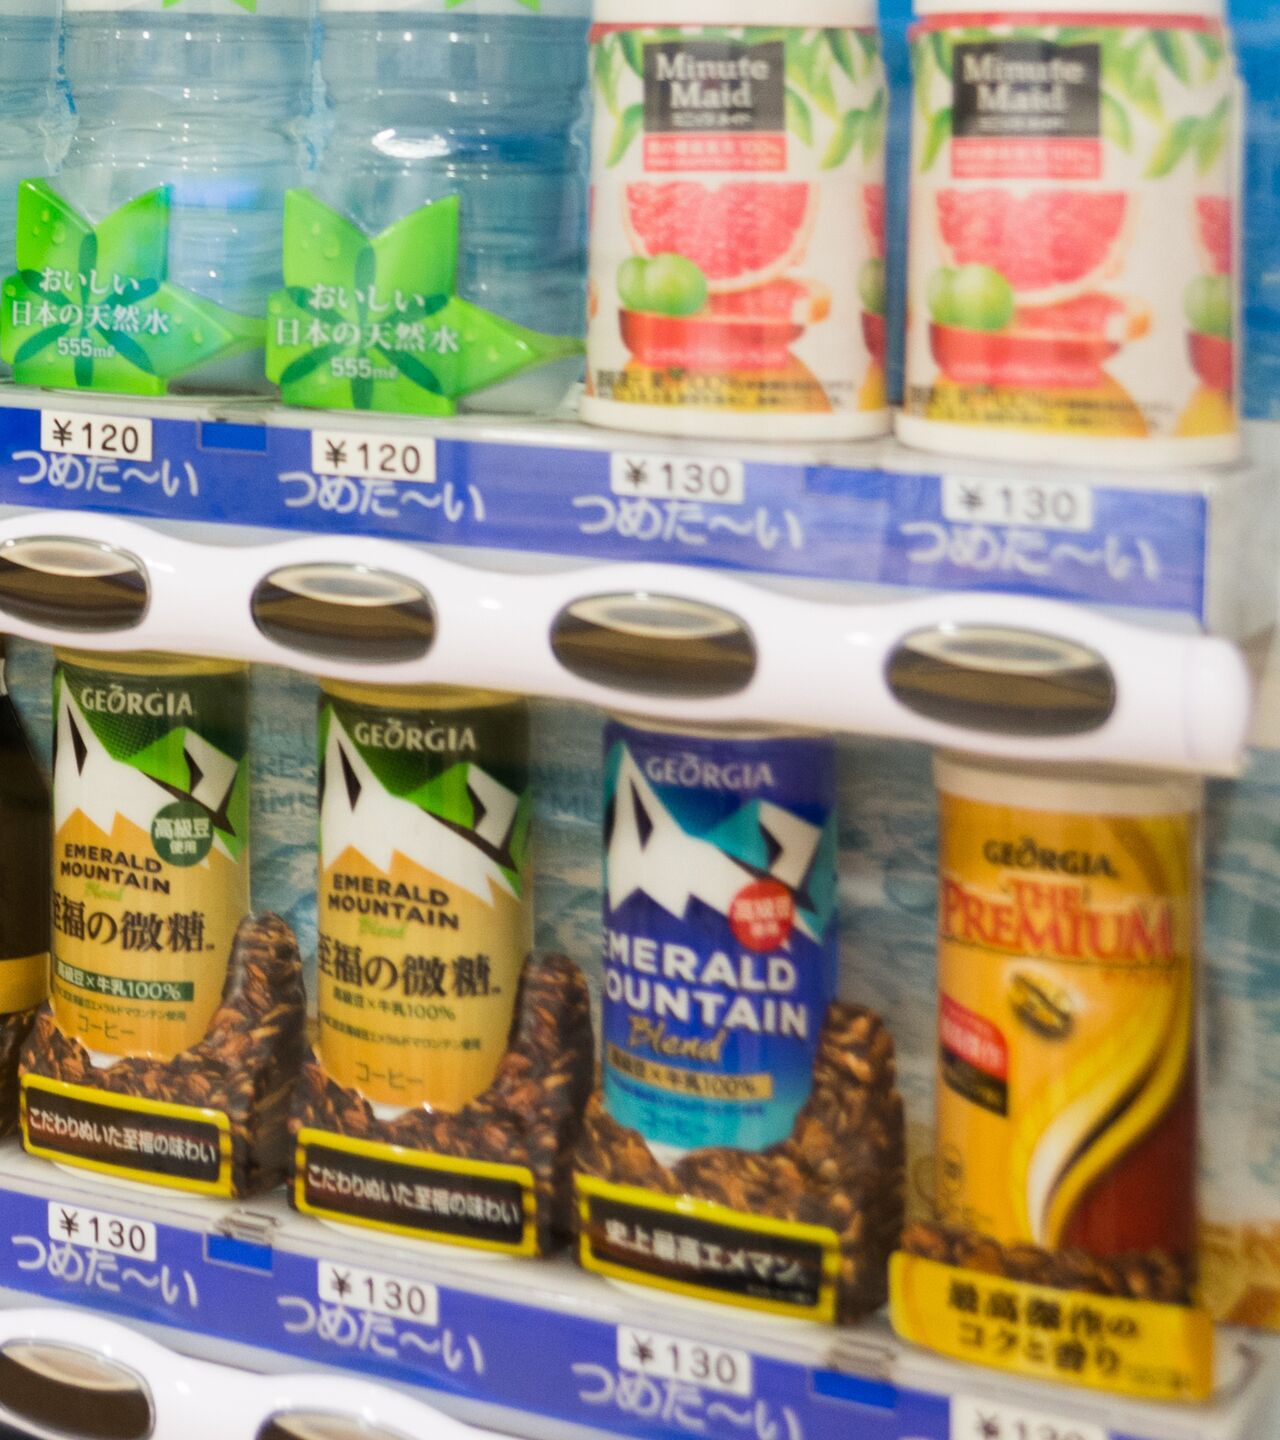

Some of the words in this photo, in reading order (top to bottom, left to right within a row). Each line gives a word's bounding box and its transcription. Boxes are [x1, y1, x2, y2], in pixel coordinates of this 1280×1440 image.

[655, 52, 771, 82] Minute
[963, 54, 1086, 85] Minute
[670, 81, 753, 110] Maid
[39, 266, 140, 296] おいしい
[309, 284, 426, 313] おいしい
[11, 301, 171, 335] 日本の天然水
[275, 319, 461, 354] 日本の天然水
[51, 418, 140, 456] ¥120
[324, 440, 422, 476] ¥120
[620, 459, 731, 496] ¥130
[957, 483, 1077, 523] ¥130
[80, 683, 194, 718] GEORGIA
[153, 815, 210, 840] 高級豆
[63, 842, 164, 875] EMERALD
[59, 859, 171, 896] MOUNTAIN
[332, 873, 450, 908] EMERALD
[1013, 876, 1082, 915] THE
[327, 893, 460, 931] MOUNTAIN
[943, 876, 1174, 959] PREMIUM
[604, 929, 798, 993] MERALD
[606, 968, 809, 1040] OUNTAIN
[77, 1014, 136, 1040] コーヒー
[628, 1014, 729, 1062] Blend
[28, 1105, 216, 1164] こだわりぬいた至福の味わい
[57, 1209, 148, 1253] ¥130
[327, 1268, 429, 1318] ¥130
[628, 1333, 739, 1385] ¥130
